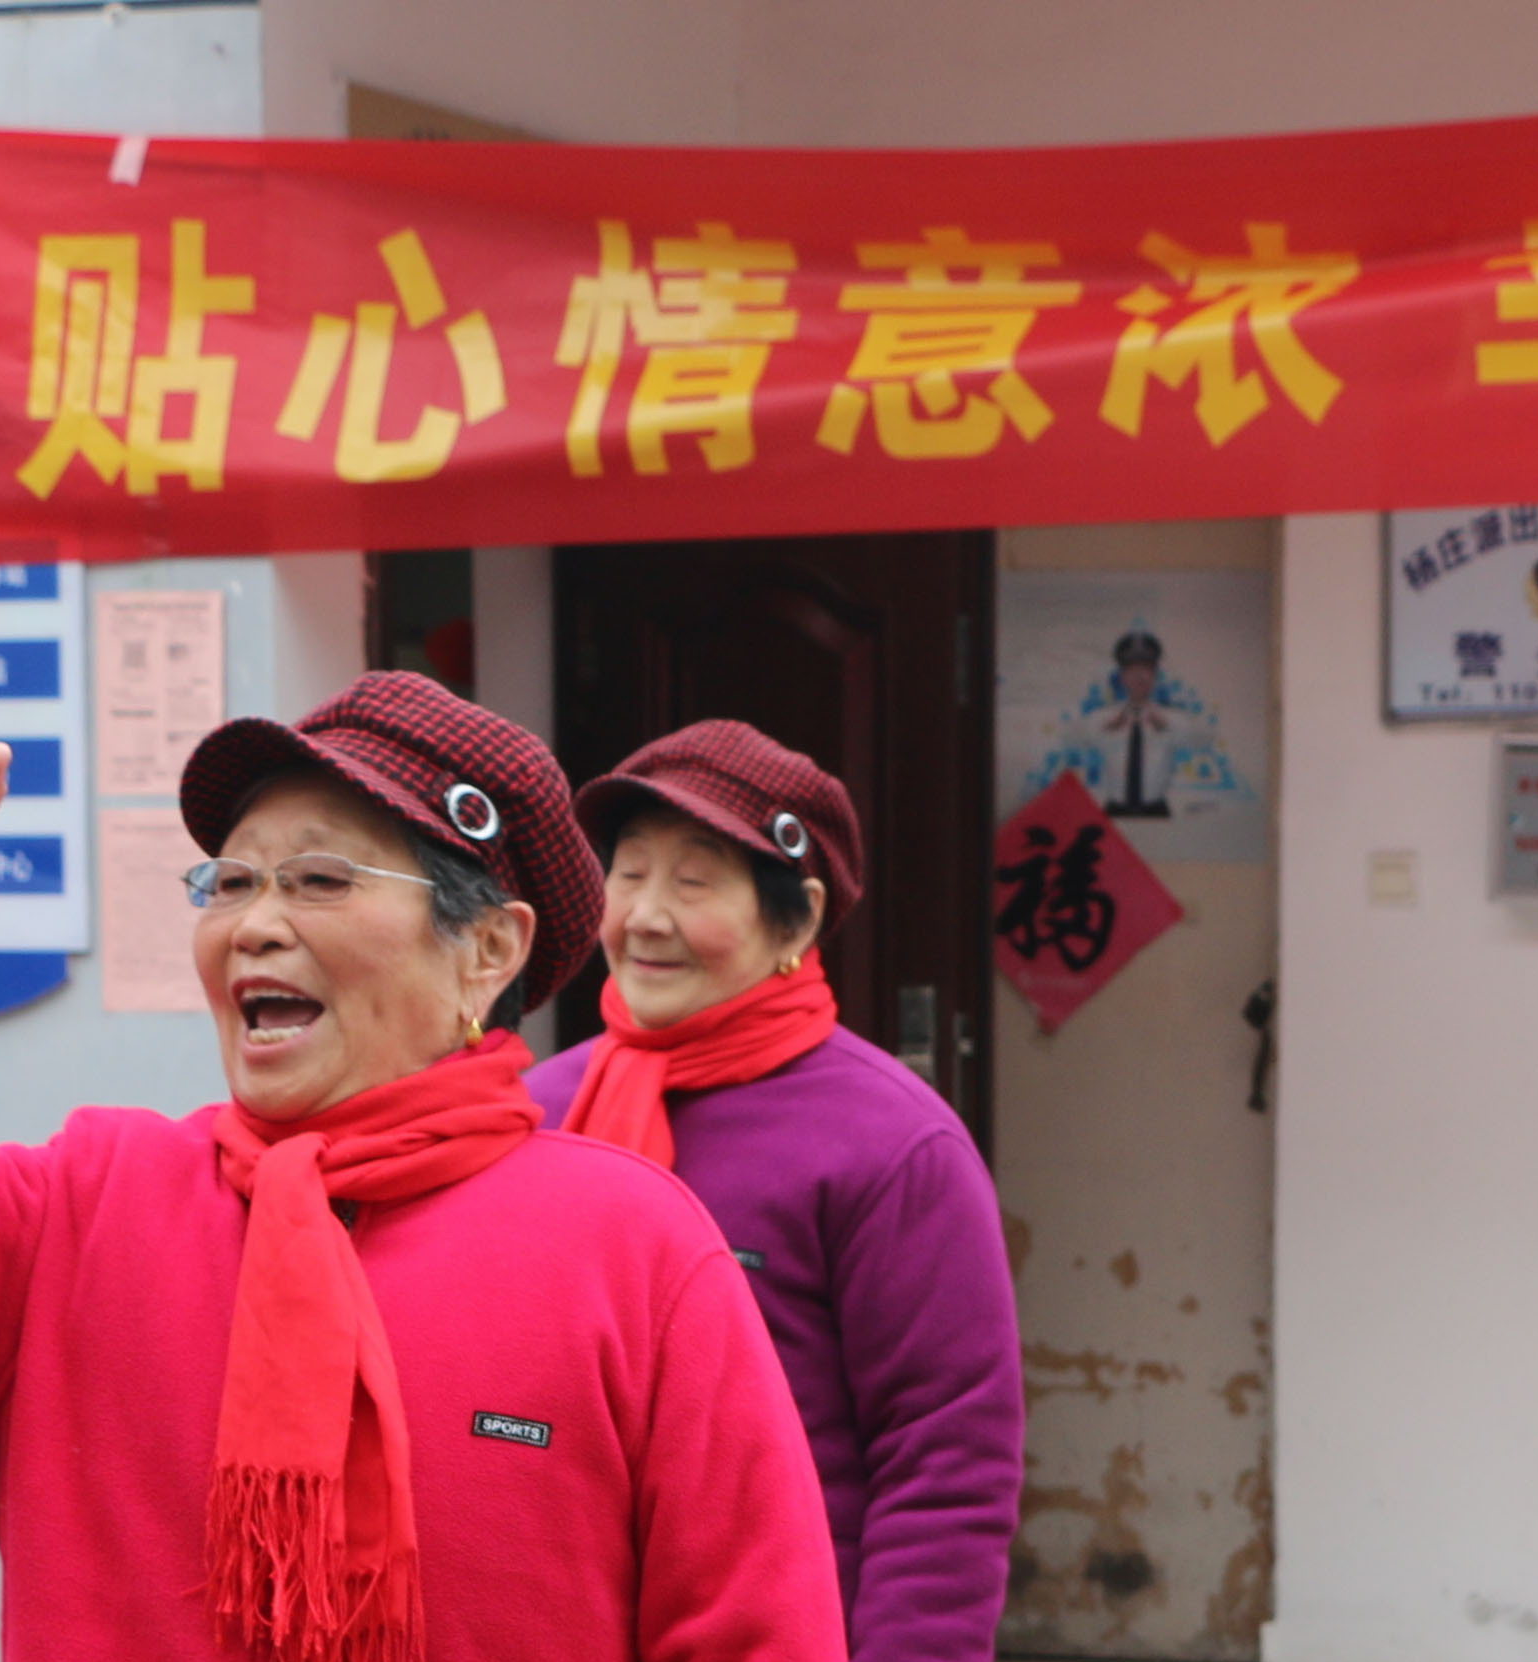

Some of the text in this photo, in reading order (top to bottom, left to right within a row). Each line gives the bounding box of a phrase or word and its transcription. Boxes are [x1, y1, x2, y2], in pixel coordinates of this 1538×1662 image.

[17, 219, 1361, 498] 贴心情意浓
[994, 823, 1116, 972] 福
[482, 1418, 542, 1440] SPORTS
